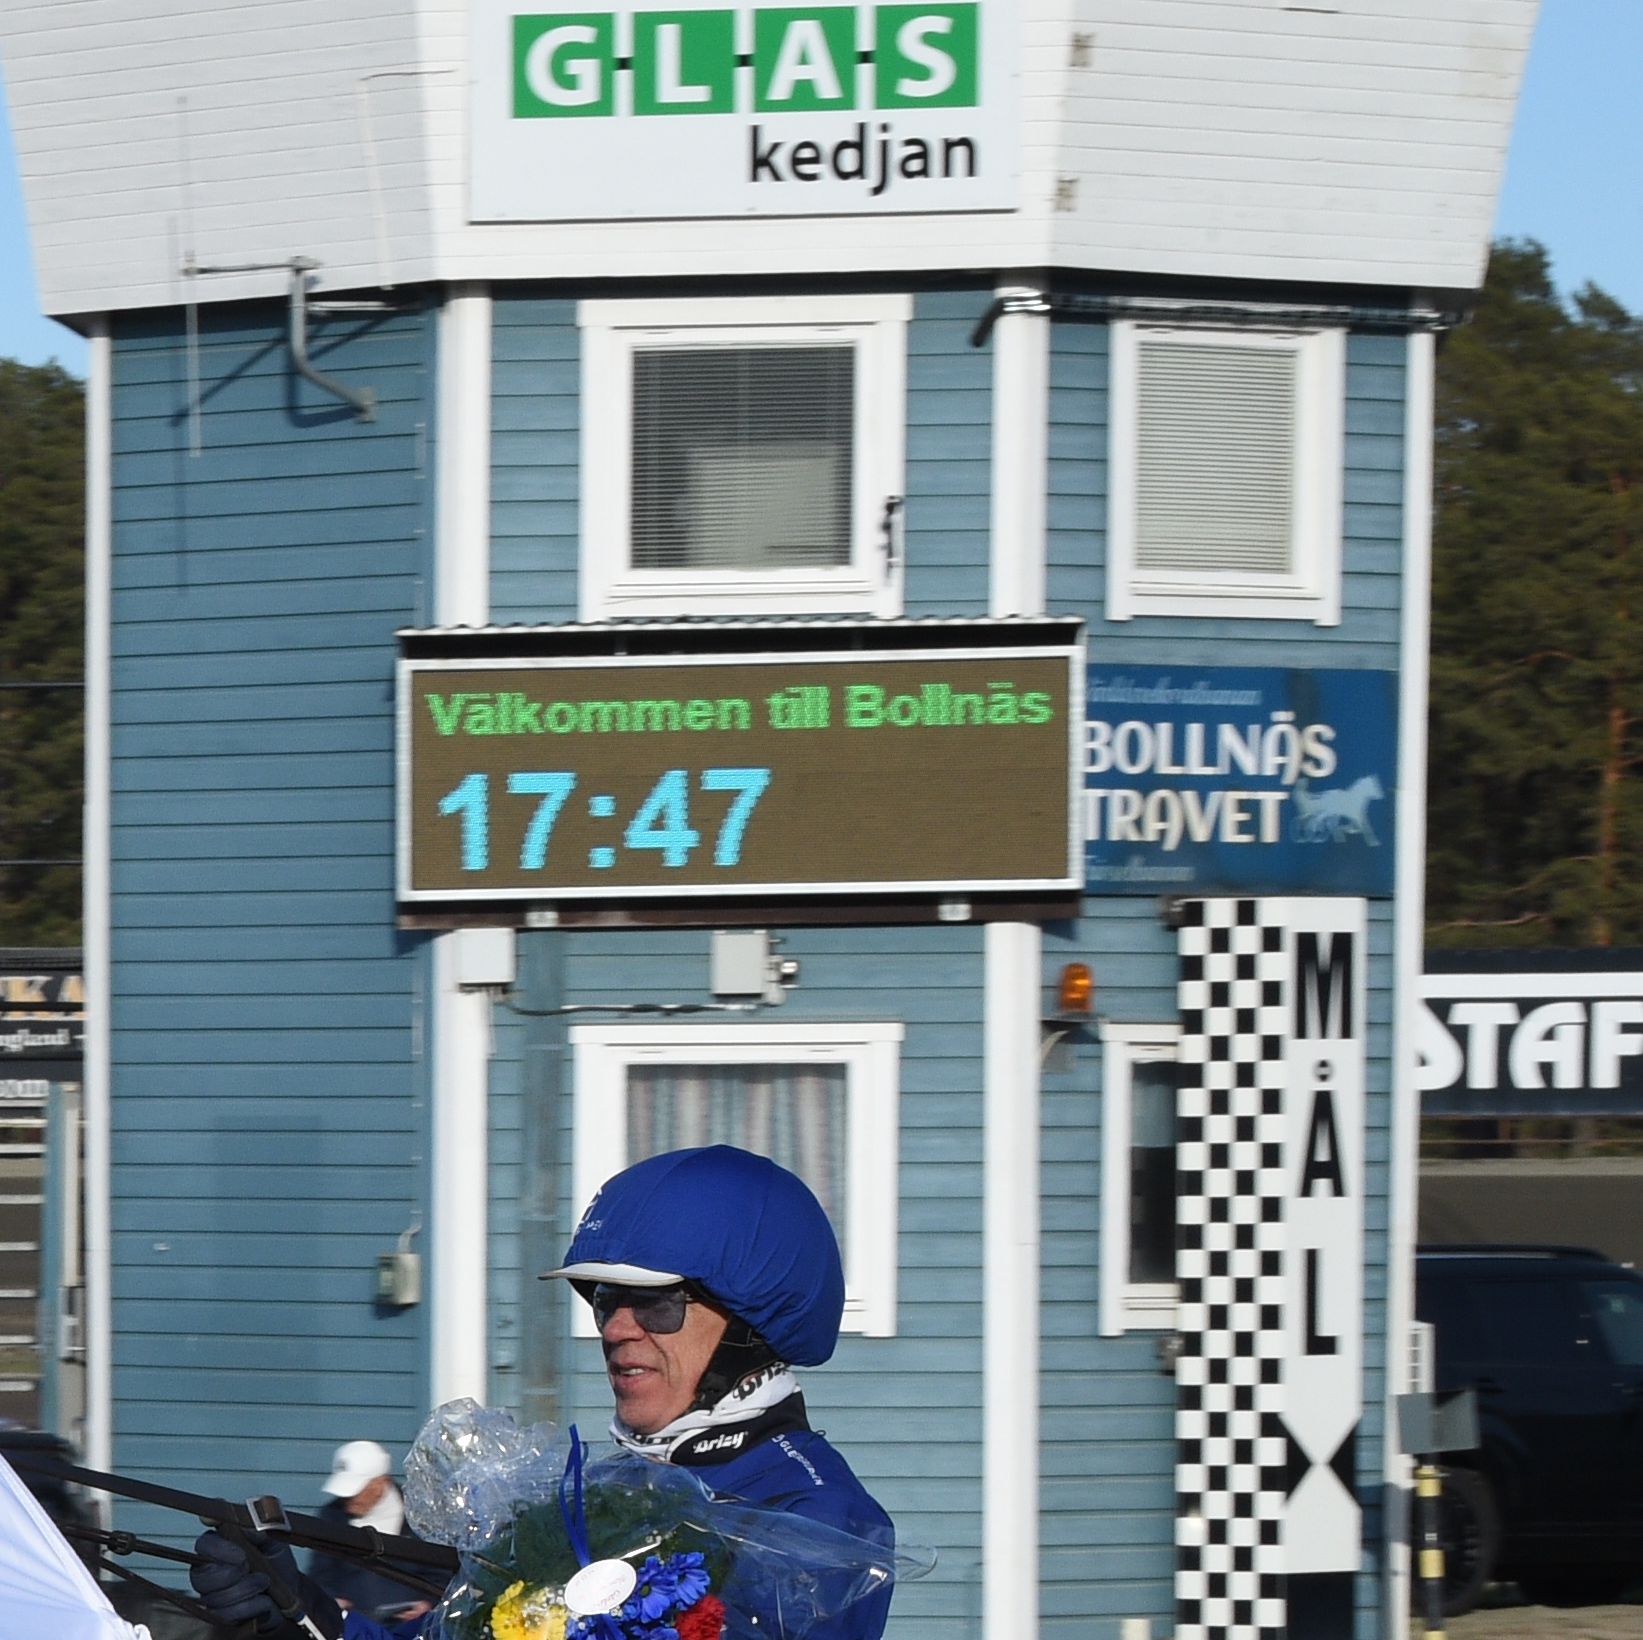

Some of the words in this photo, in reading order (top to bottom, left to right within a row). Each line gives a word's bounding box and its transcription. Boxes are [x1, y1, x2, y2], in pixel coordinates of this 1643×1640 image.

[748, 122, 979, 197] kedjan
[426, 691, 751, 736] Välkommen
[767, 685, 831, 729] till
[846, 682, 1054, 729] Bollnäs
[1083, 710, 1338, 786] BOLLNÄS
[437, 767, 772, 870] 17:47
[1083, 788, 1291, 851] TRAVET
[1295, 932, 1355, 1356] MÅL
